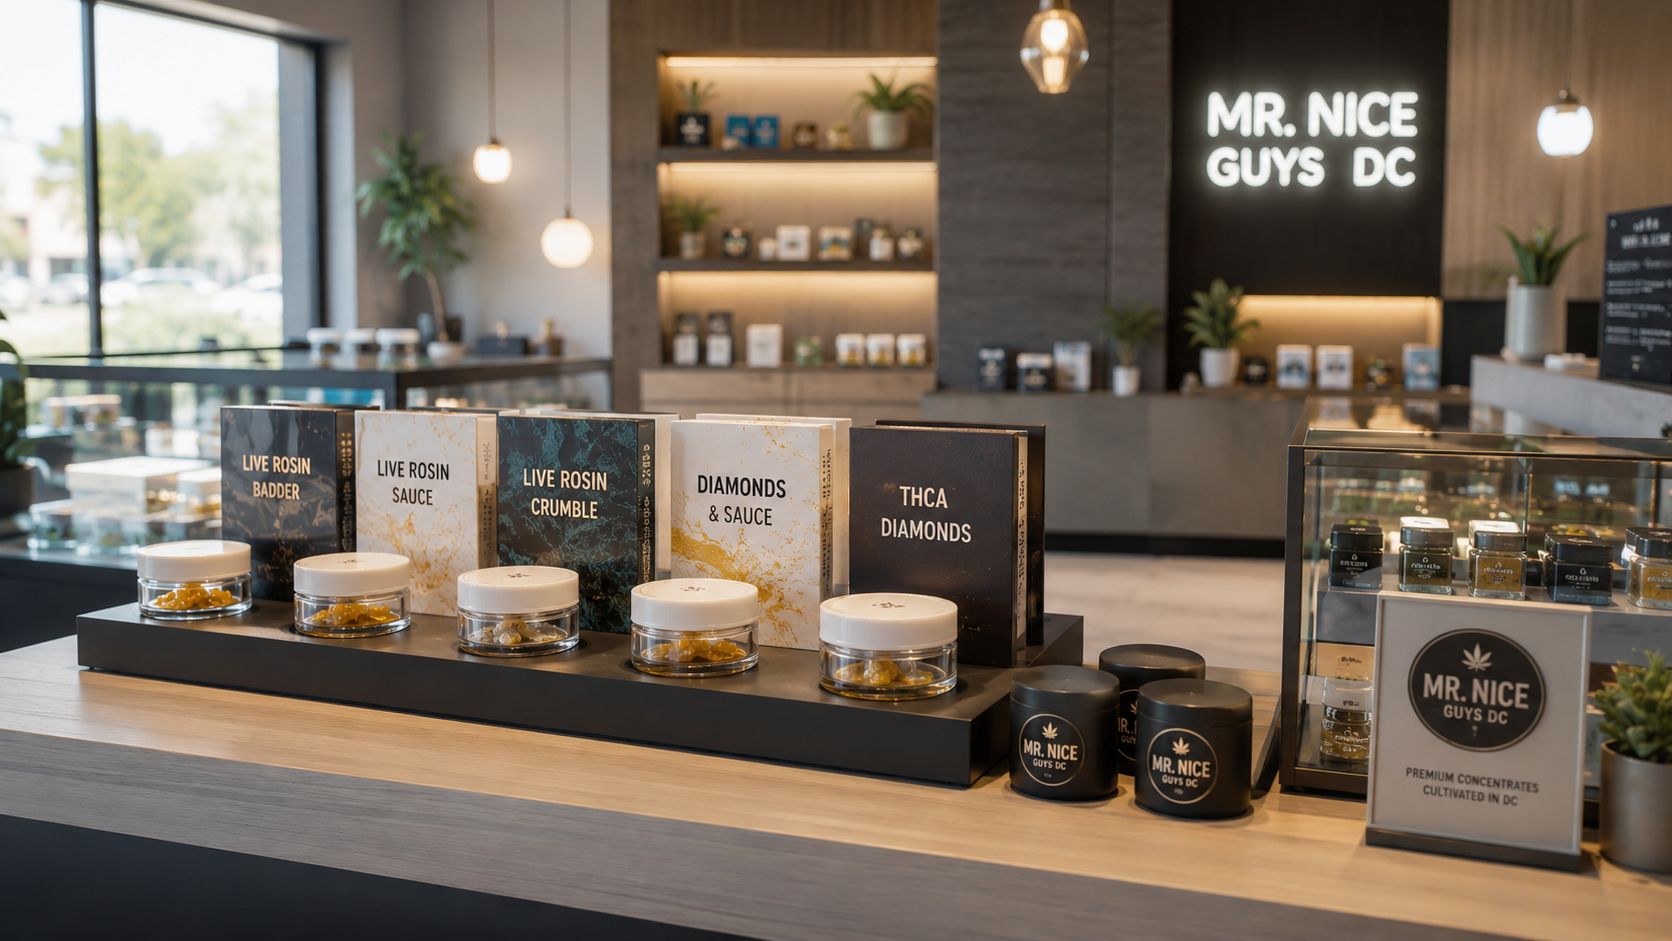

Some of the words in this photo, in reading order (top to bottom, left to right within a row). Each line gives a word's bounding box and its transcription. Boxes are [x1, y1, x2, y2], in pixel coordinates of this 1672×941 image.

[1207, 91, 1297, 138] MR.
[1308, 91, 1419, 138] NICE
[1206, 146, 1325, 187] GUYS
[1353, 146, 1416, 187] DC
[242, 454, 269, 472] LIVE
[272, 456, 311, 475] ROSIN
[377, 459, 405, 478] LIVE
[409, 461, 450, 480] ROSIN
[252, 481, 300, 500] BADDER
[523, 468, 555, 488] LIVE
[560, 470, 607, 491] ROSIN
[697, 474, 786, 498] DIAMONDS
[392, 486, 433, 506] SAUCE
[899, 486, 948, 509] THCA
[531, 497, 598, 519] CRUMBLE
[709, 505, 719, 522] &
[724, 505, 773, 526] SAUCE
[881, 517, 972, 543] DIAMONDS
[1423, 672, 1467, 703] MR.
[1472, 678, 1530, 710] NICE
[1443, 705, 1482, 722] GUYS
[1487, 709, 1508, 725] DC
[1023, 738, 1044, 758] MR.
[1047, 743, 1078, 761] NICE
[1032, 758, 1053, 769] GUYS
[1055, 761, 1067, 771] DC
[1152, 754, 1175, 774] MR.
[1178, 759, 1211, 778] NICE
[1161, 774, 1184, 786] GUYS
[1185, 778, 1199, 788] DC
[1406, 766, 1454, 783] PREMIUM
[1457, 773, 1540, 793] CONCENTRATES
[1423, 785, 1485, 803] CULTIVATED
[1488, 794, 1499, 805] IN
[1503, 795, 1518, 806] DC
